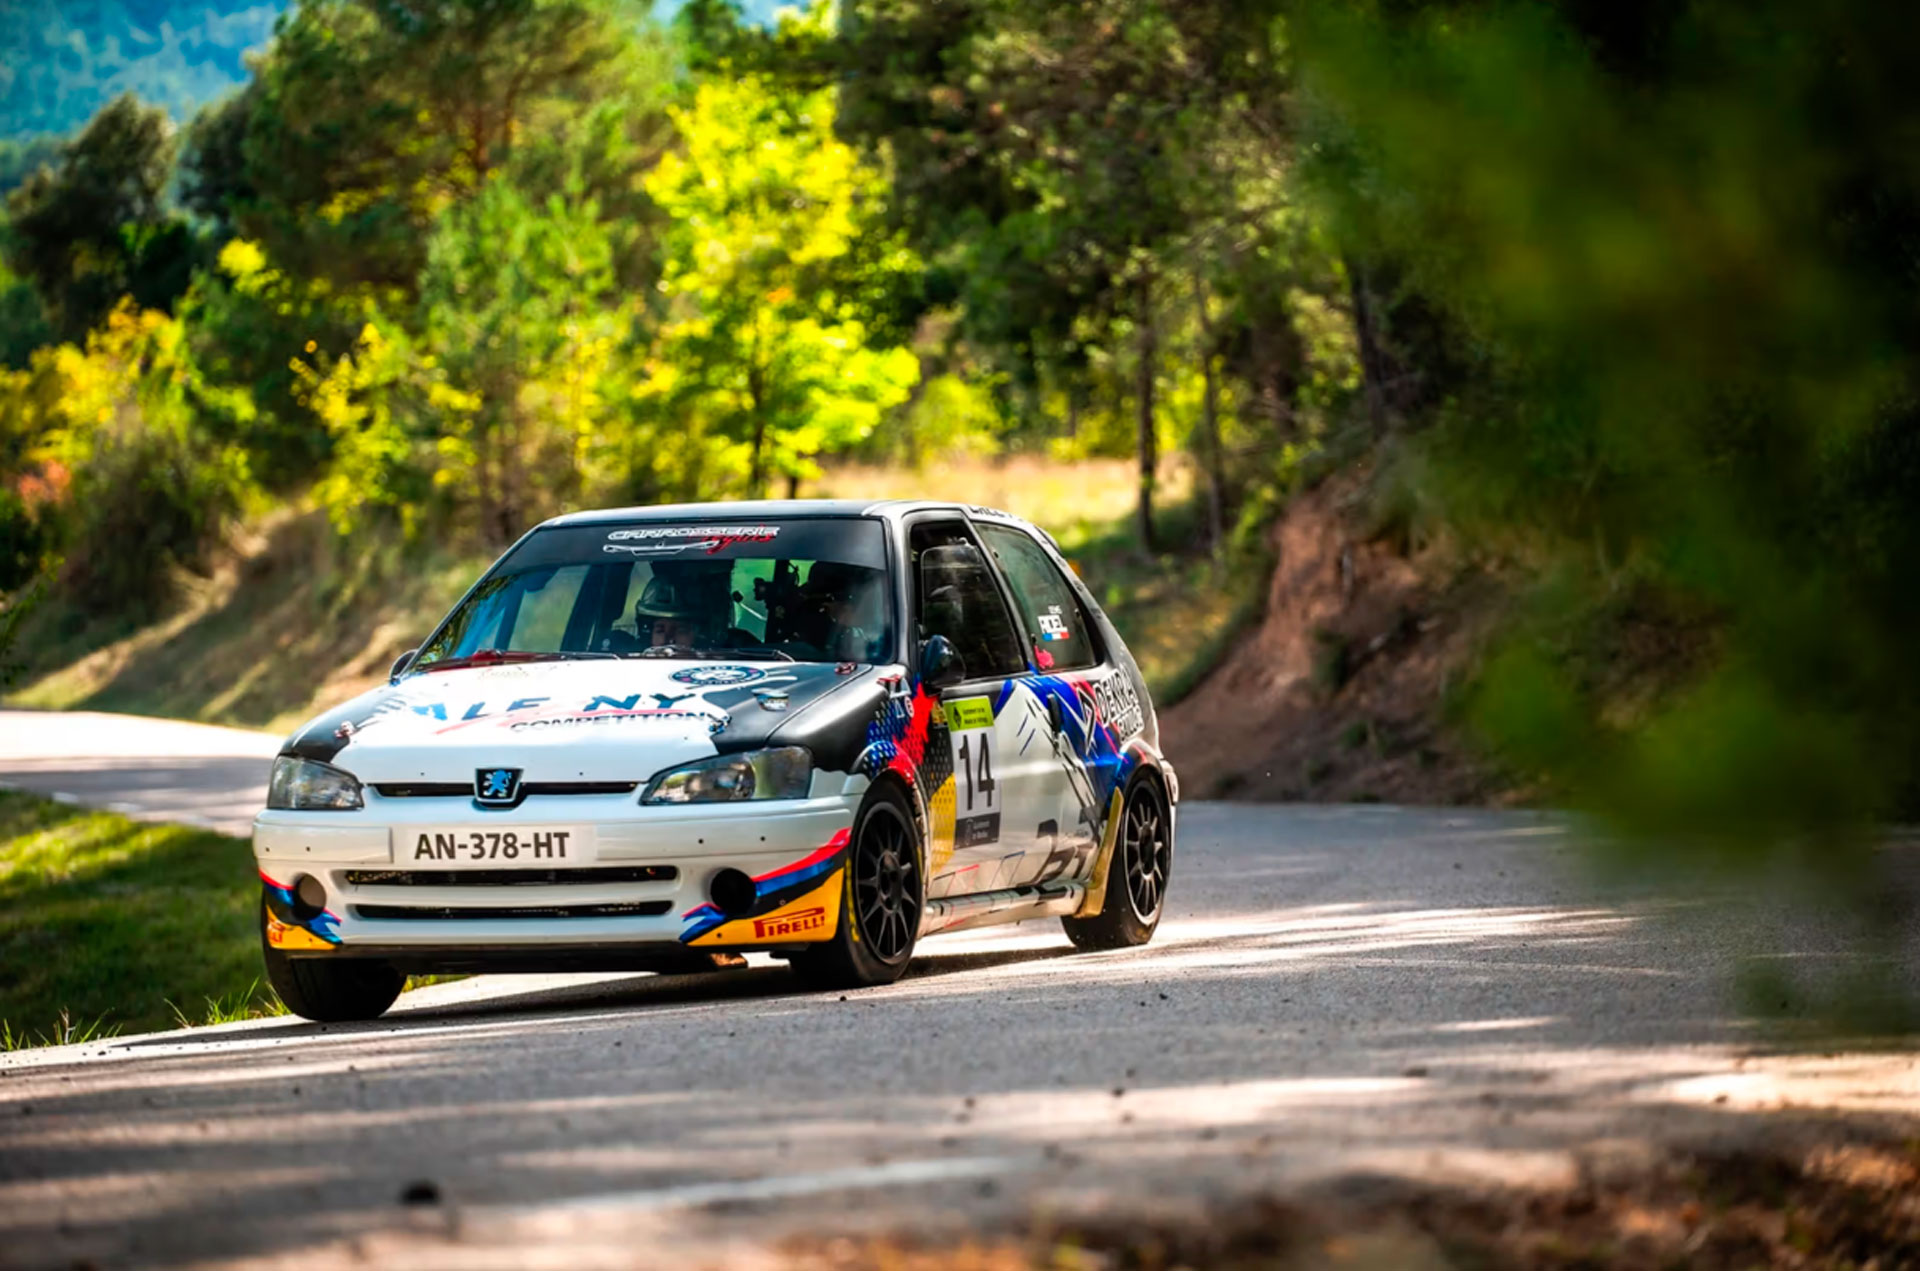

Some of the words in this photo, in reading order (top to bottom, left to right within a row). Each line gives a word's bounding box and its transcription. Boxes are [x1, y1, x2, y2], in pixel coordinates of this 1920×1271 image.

[958, 732, 995, 811] 14
[414, 831, 570, 861] AN-378-HT
[752, 906, 825, 939] PIRELLI
